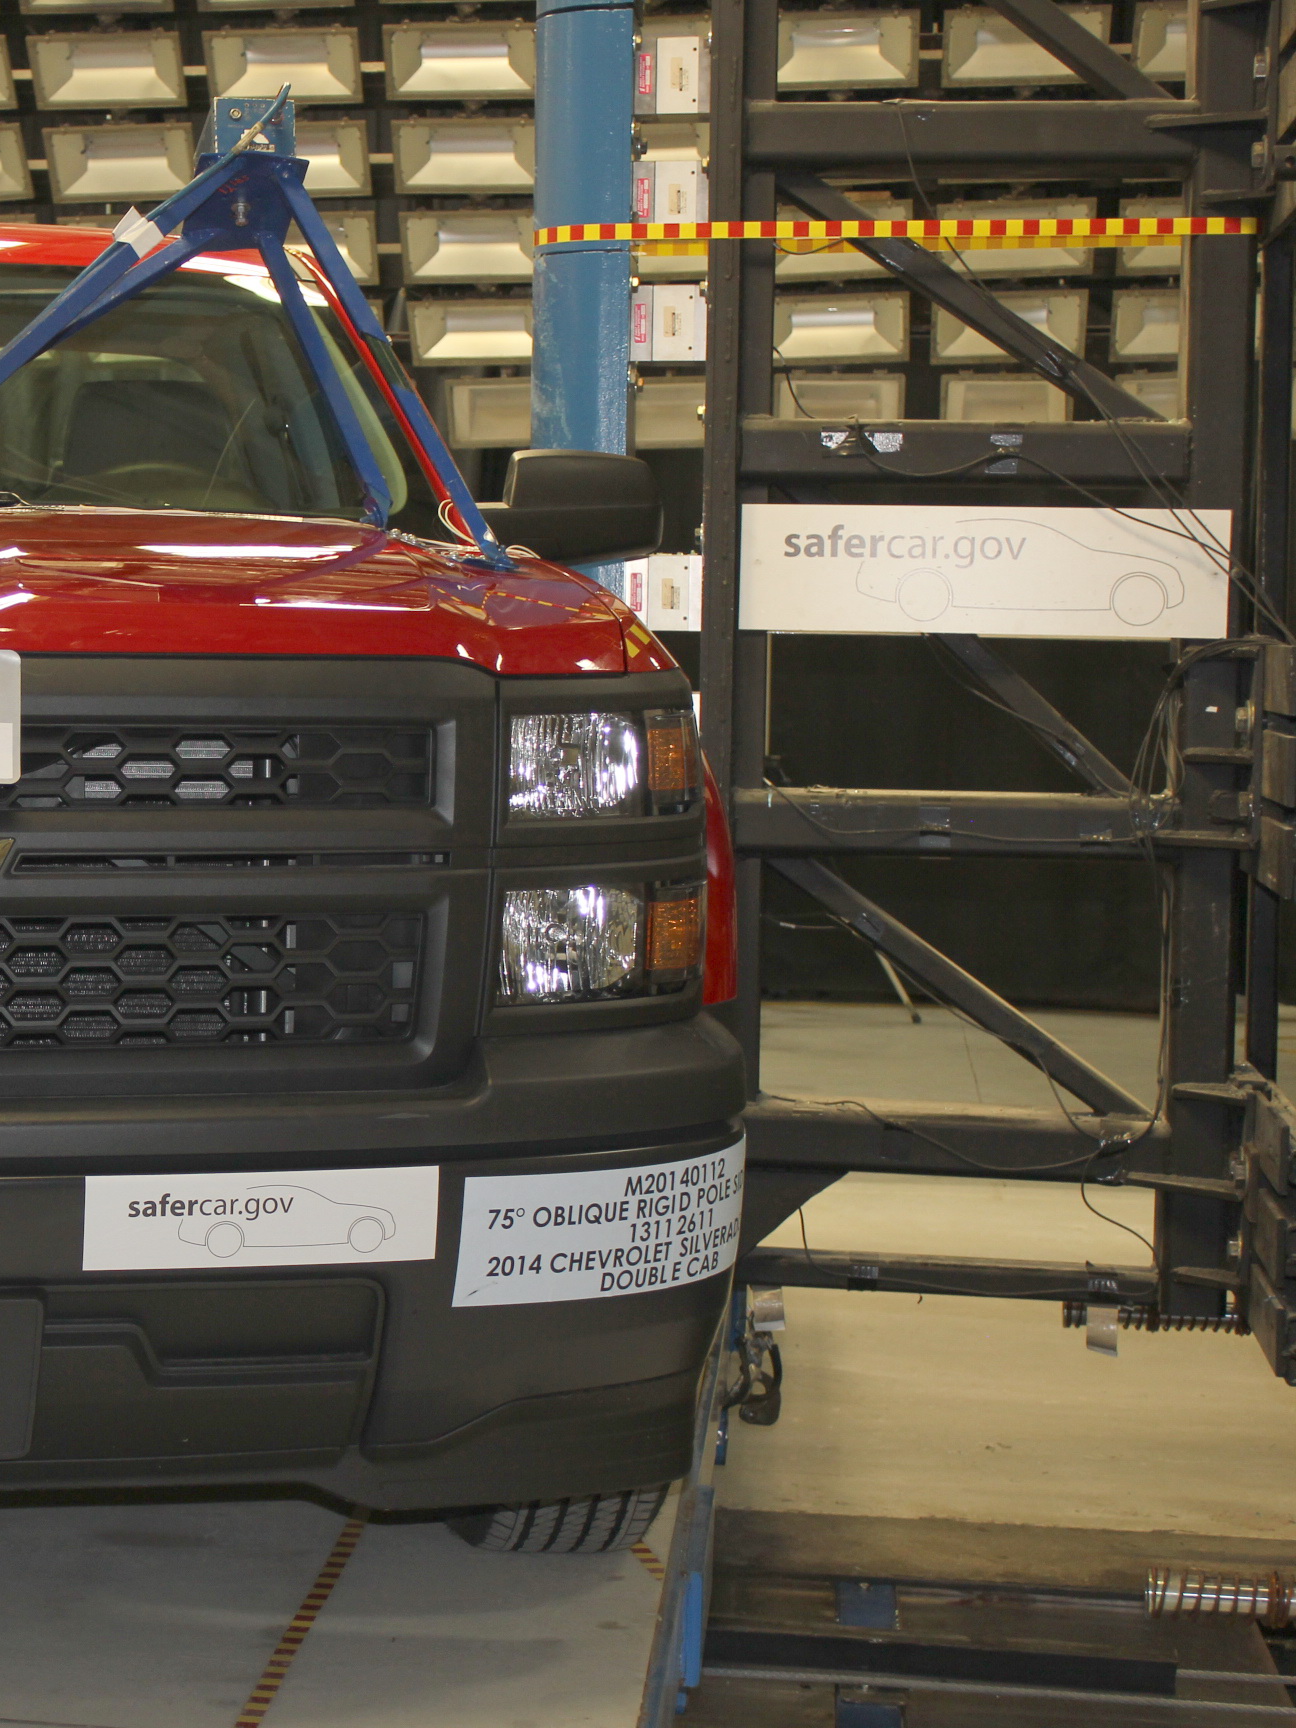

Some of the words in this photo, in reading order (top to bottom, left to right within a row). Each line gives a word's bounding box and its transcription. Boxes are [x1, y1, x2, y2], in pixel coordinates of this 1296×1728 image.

[783, 524, 1027, 569] safercar.gov
[624, 1158, 726, 1196] M20140112
[128, 1193, 294, 1221] safercar.gov
[533, 1201, 629, 1227] OBLIQUE
[636, 1186, 691, 1219] RIGID
[697, 1178, 731, 1208] POLE
[629, 1208, 714, 1243] 13112611
[486, 1255, 542, 1277] 2014
[550, 1242, 673, 1274] CHEVROLET
[599, 1261, 681, 1292] DOUBLE
[686, 1250, 719, 1278] CAB
